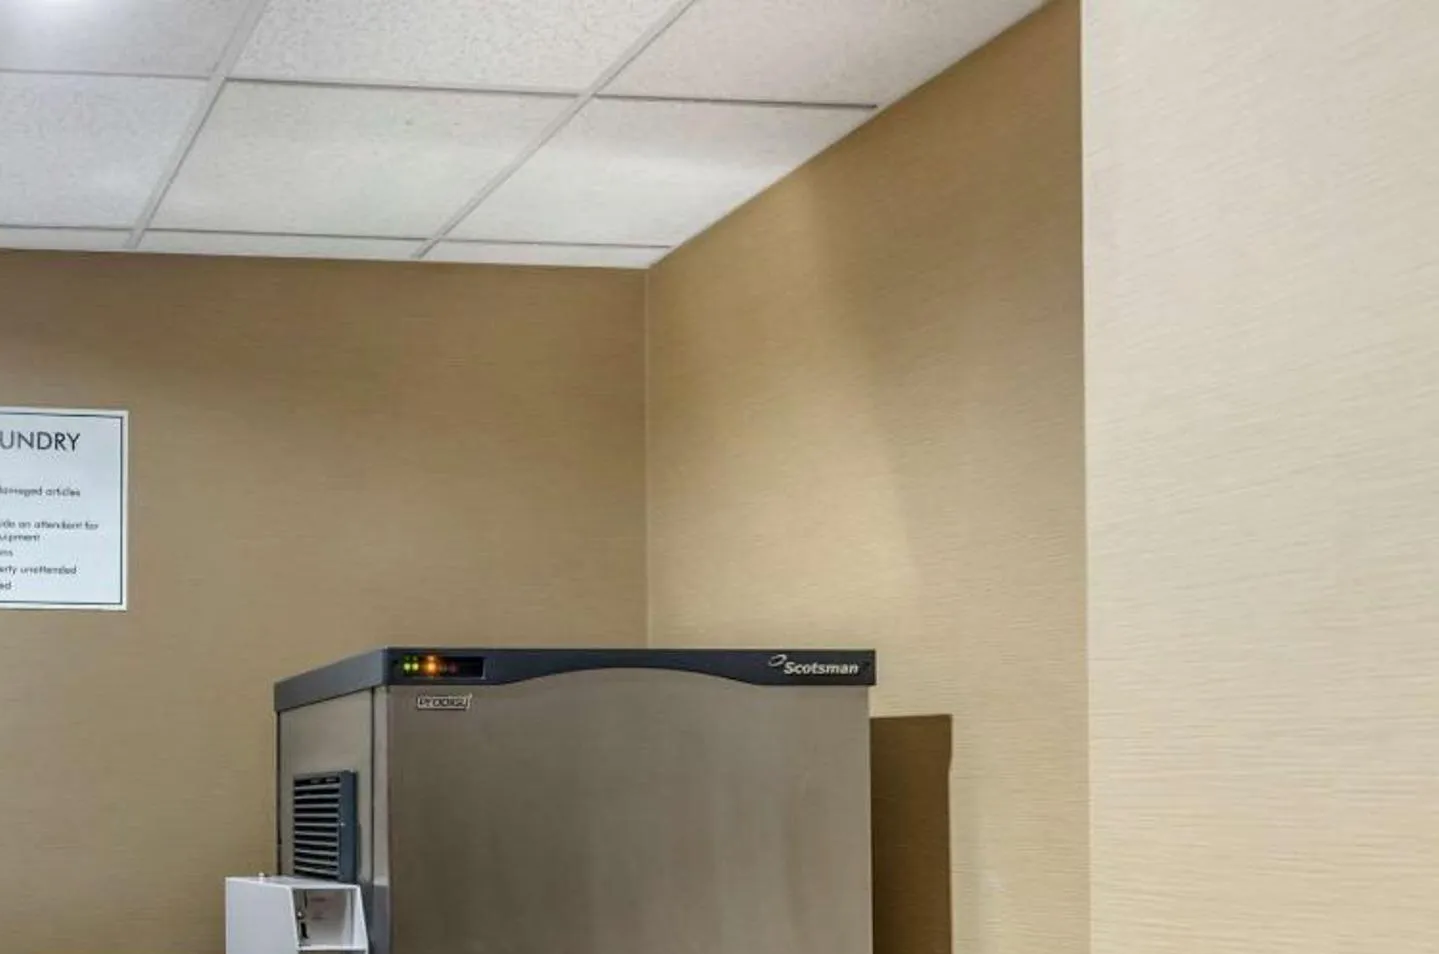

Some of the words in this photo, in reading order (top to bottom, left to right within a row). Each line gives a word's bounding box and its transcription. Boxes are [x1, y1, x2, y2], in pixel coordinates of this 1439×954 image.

[45, 487, 81, 497] articles
[18, 522, 31, 530] an
[84, 520, 100, 531] for
[20, 565, 78, 576] unattended
[783, 661, 860, 675] Scotsman
